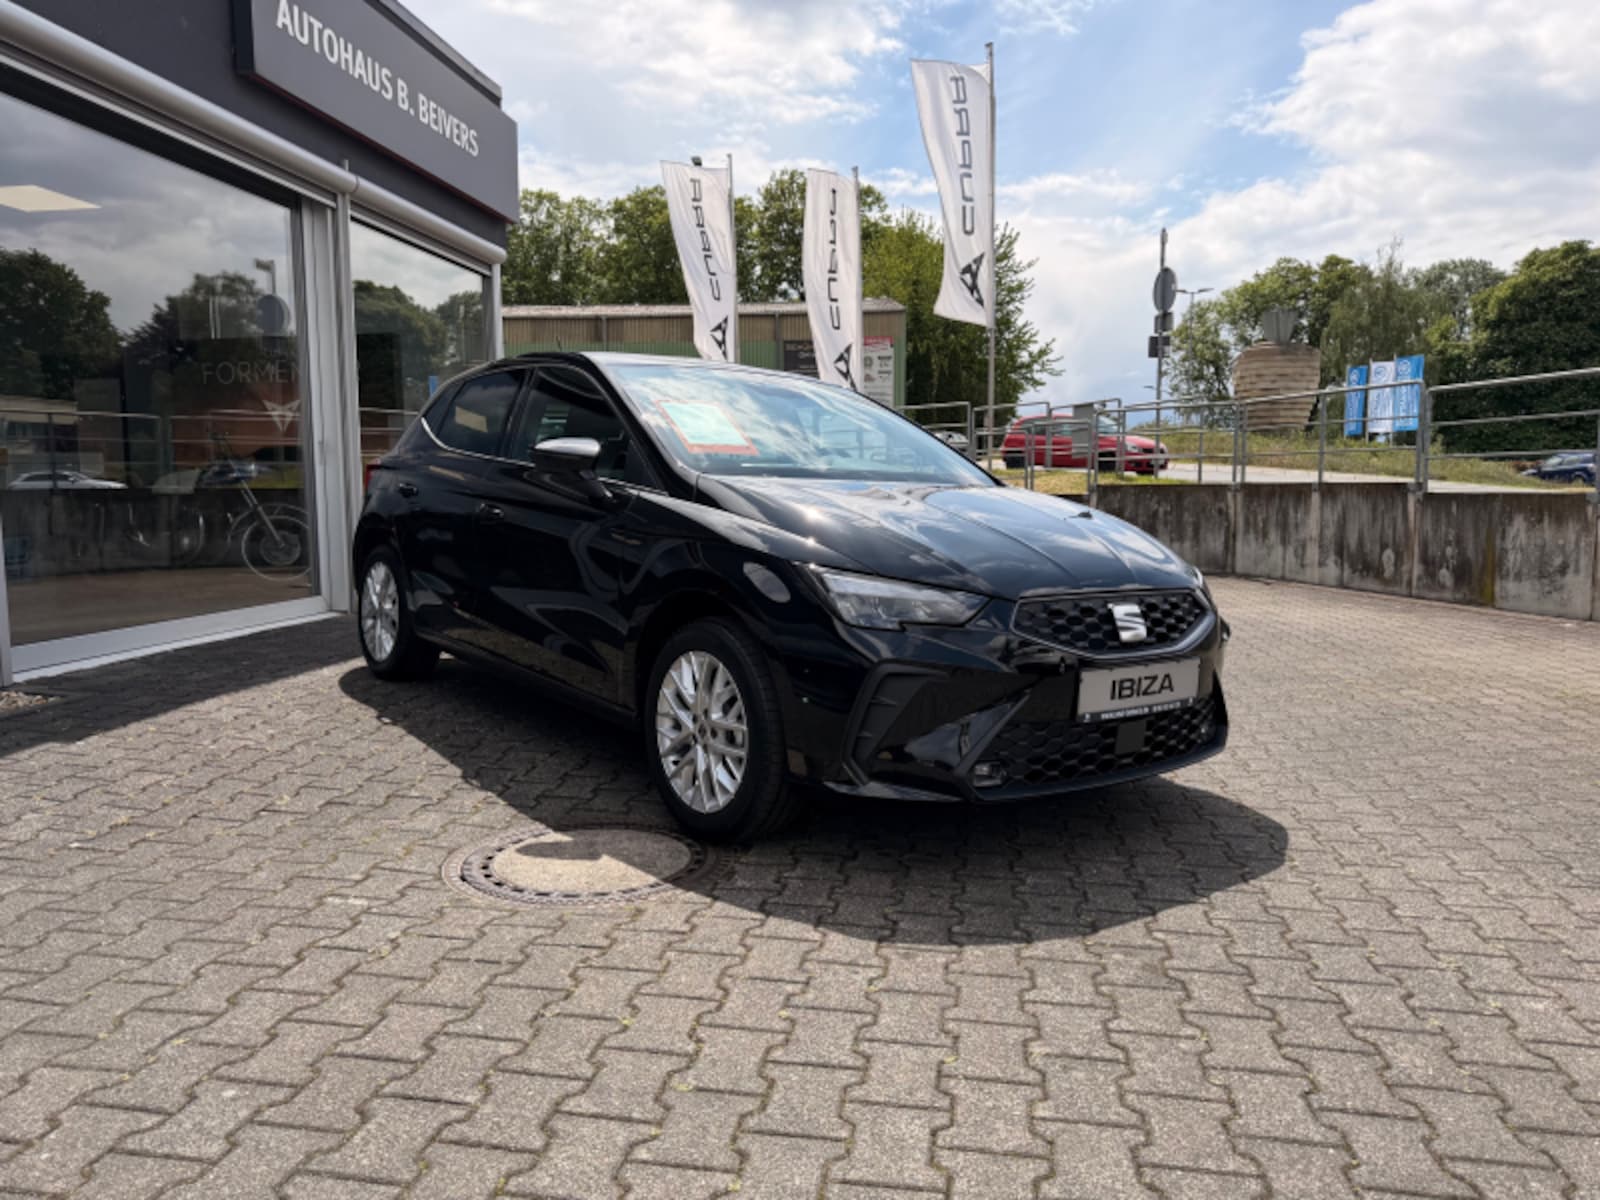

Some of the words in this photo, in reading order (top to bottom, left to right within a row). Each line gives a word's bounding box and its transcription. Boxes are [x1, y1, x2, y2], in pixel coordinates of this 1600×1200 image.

[276, 0, 394, 100] AUTOHAUS
[397, 78, 415, 116] B.
[418, 93, 479, 157] BEIVERS
[1110, 673, 1174, 701] IBIZA
